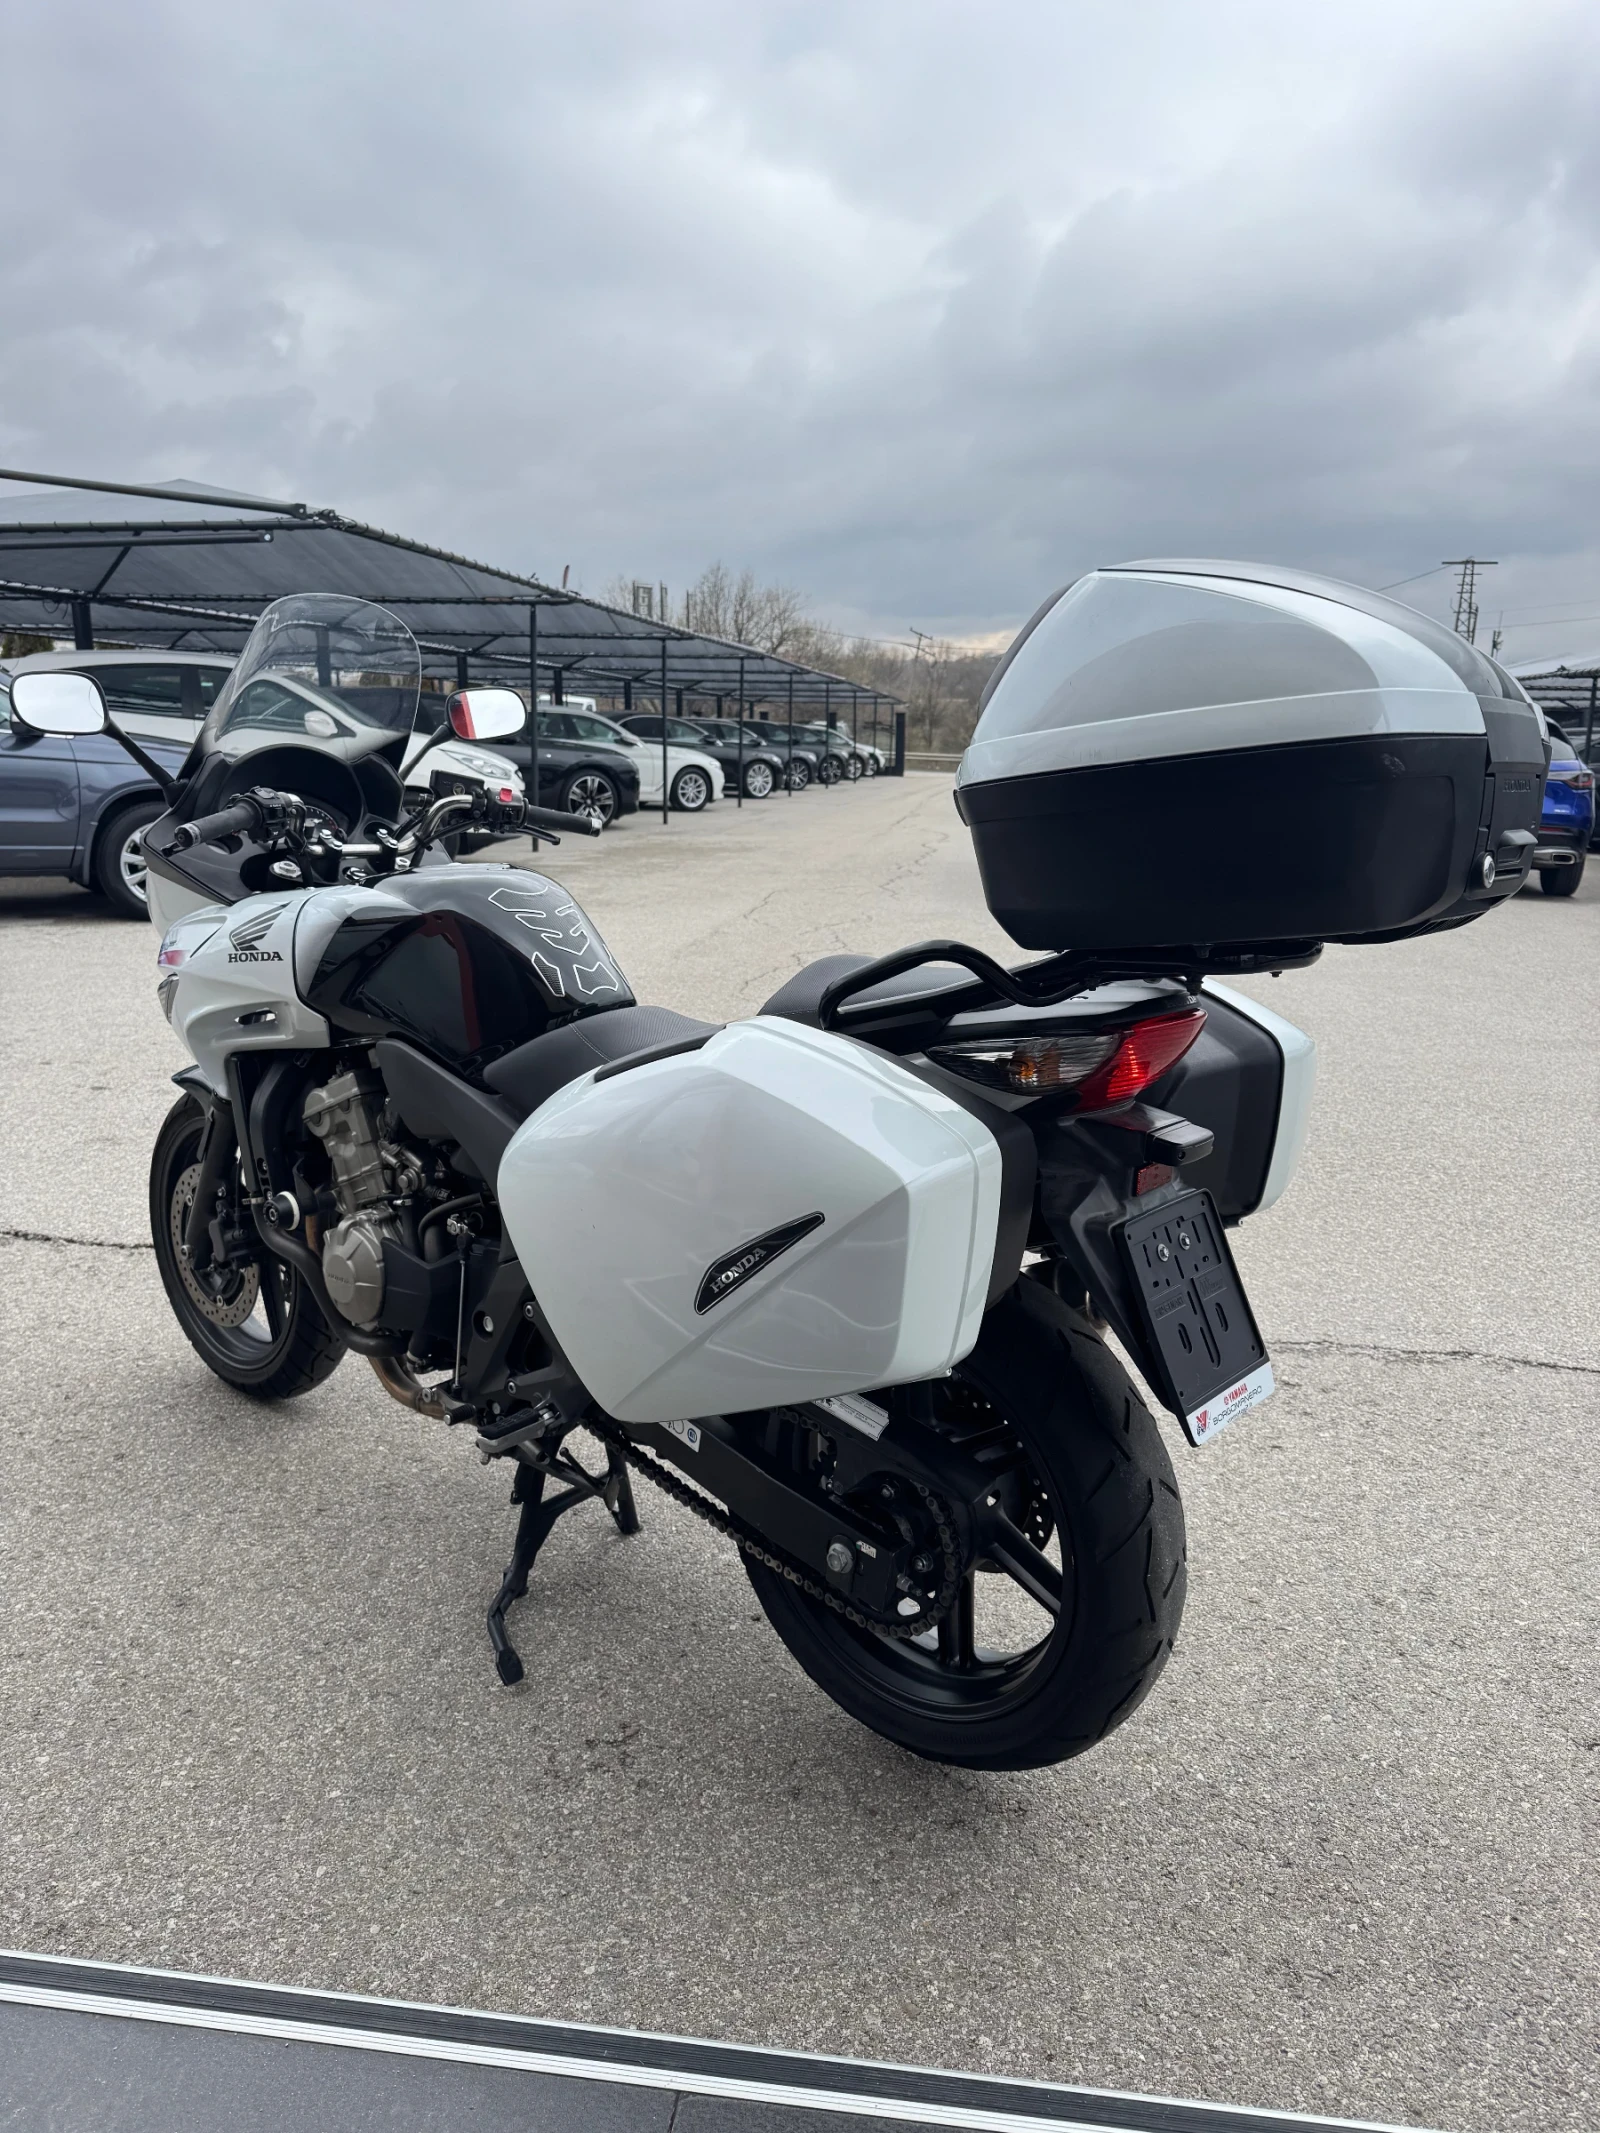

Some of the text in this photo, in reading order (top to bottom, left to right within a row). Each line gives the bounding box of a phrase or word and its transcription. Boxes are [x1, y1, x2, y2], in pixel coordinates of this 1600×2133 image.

[228, 951, 284, 963] HONDA
[710, 1247, 767, 1293] HONDA
[1212, 1385, 1263, 1426] BORGOMANERO
[1228, 1383, 1249, 1402] YAMAHA
